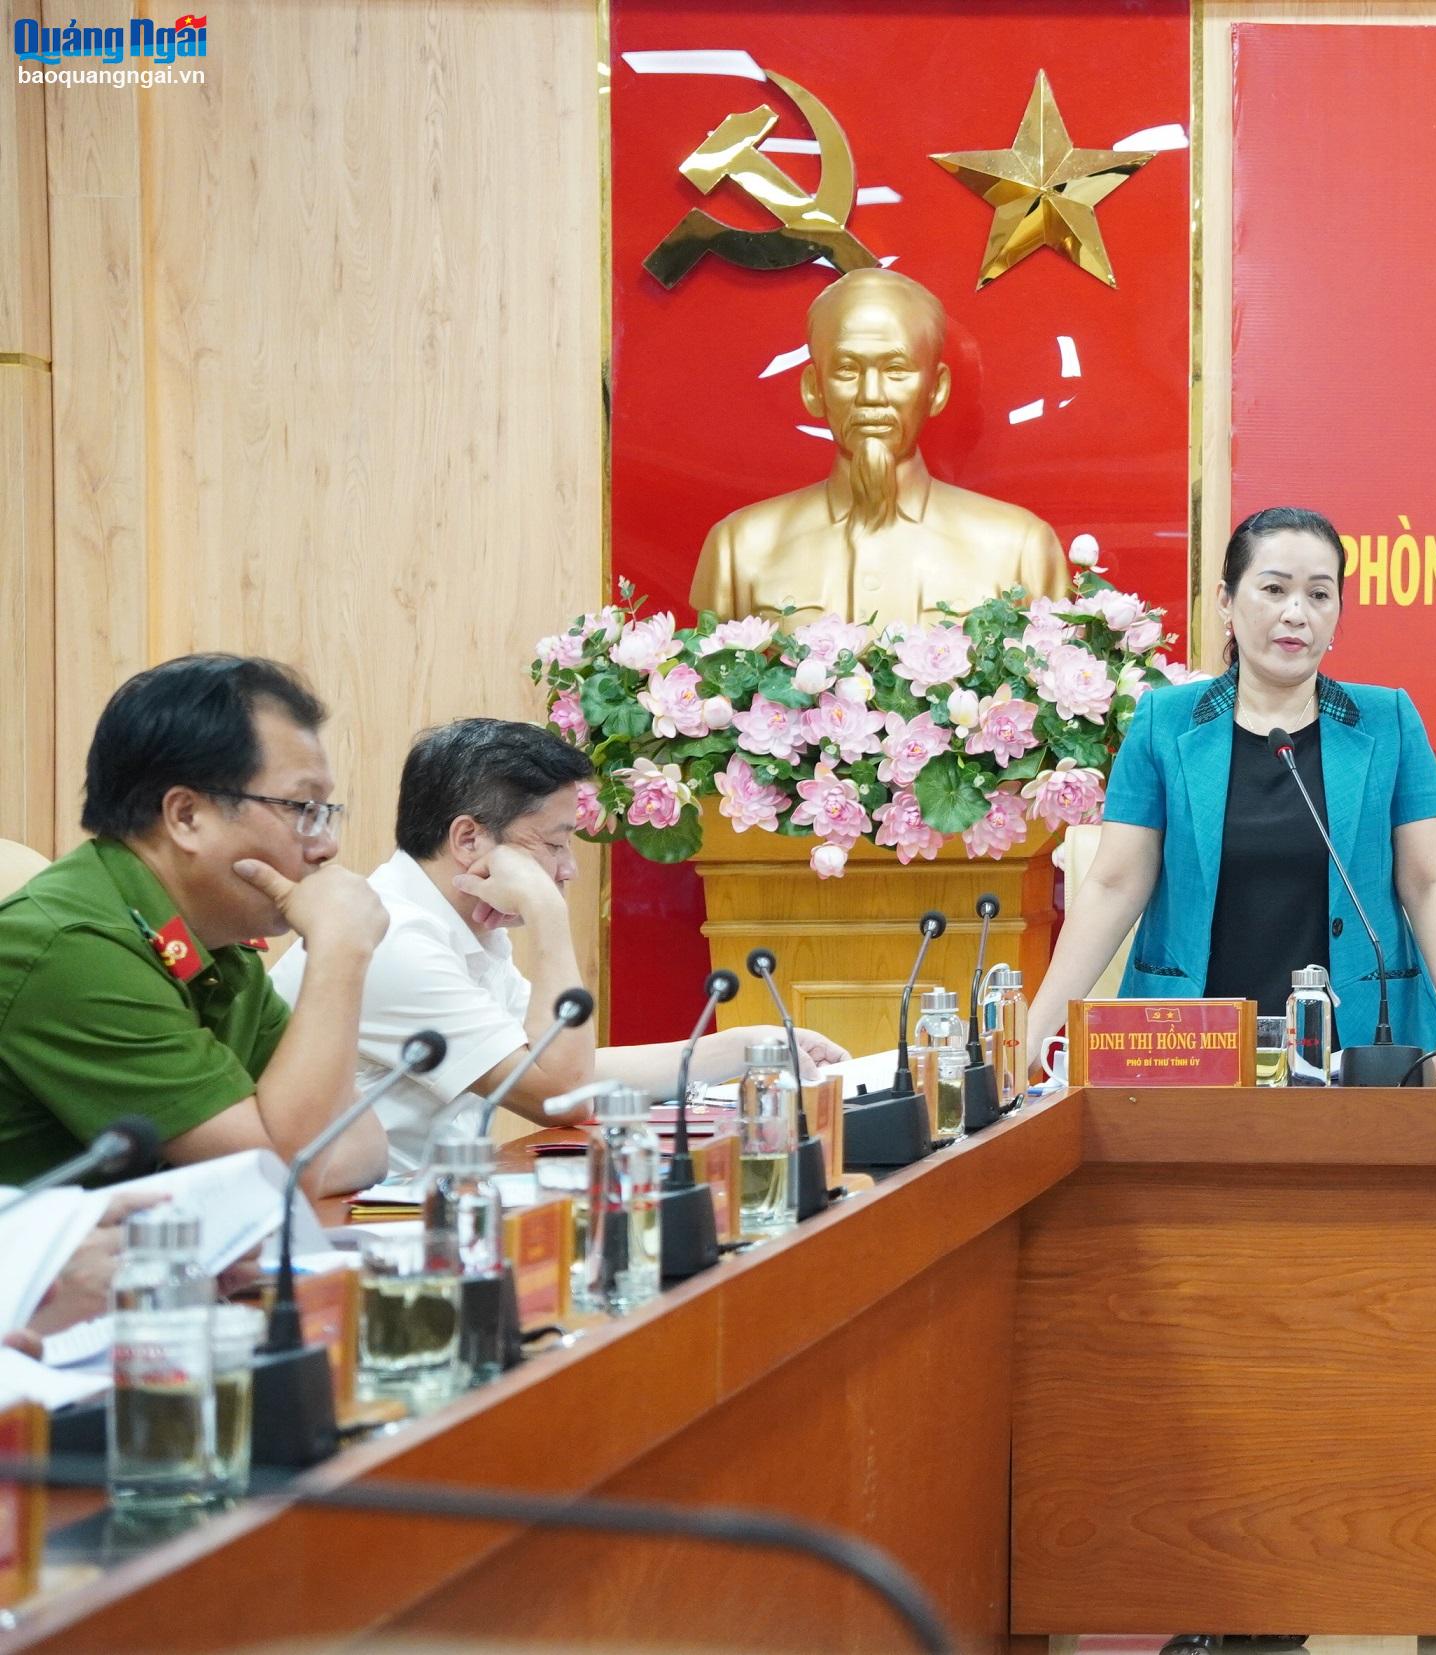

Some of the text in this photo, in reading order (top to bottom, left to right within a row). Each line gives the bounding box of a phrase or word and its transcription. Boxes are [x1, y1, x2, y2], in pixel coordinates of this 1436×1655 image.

[1089, 1024, 1238, 1054] ĐINH THỊ HỒNG MINH
